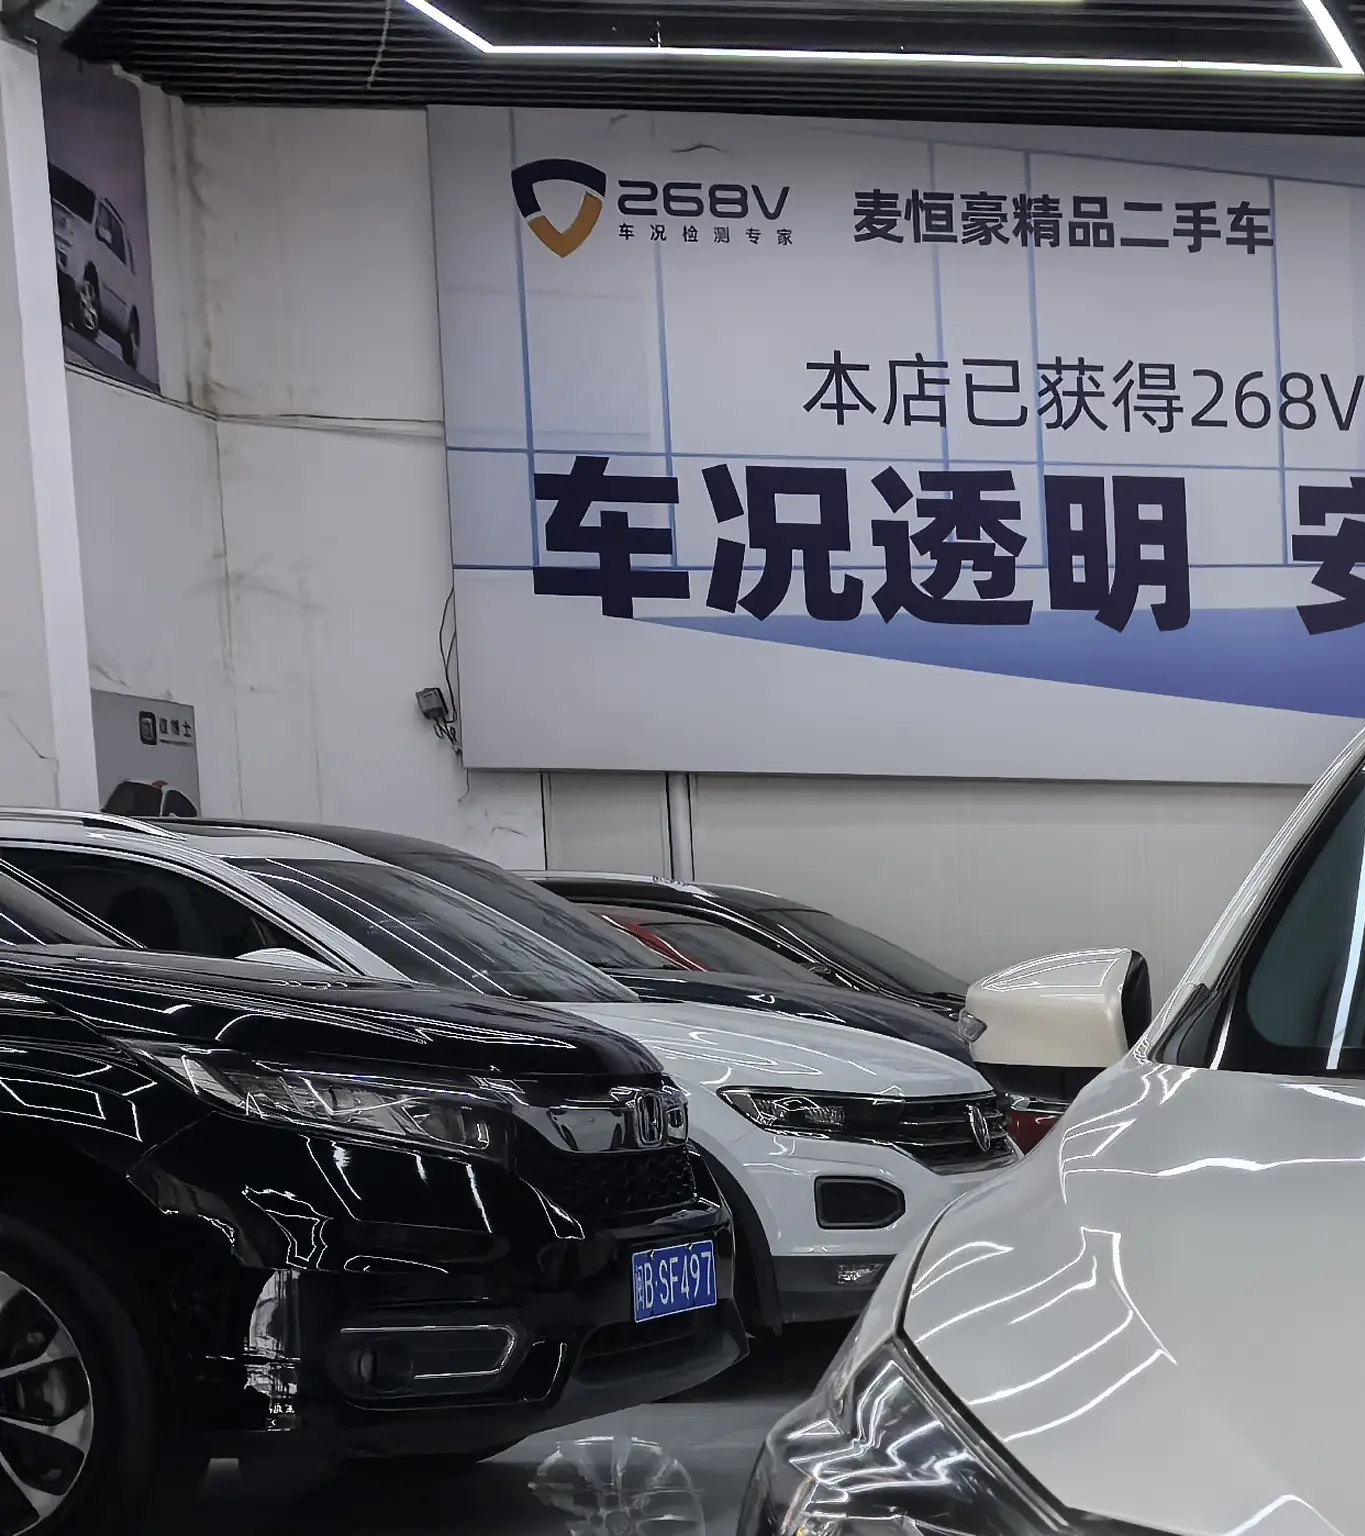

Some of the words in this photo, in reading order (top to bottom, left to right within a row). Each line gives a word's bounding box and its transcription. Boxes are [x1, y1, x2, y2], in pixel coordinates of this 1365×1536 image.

[617, 179, 790, 220] 268V
[853, 189, 1275, 255] 麦恒豪精品二手车
[618, 222, 793, 246] 车况检测专家
[533, 456, 1191, 632] 车况透明
